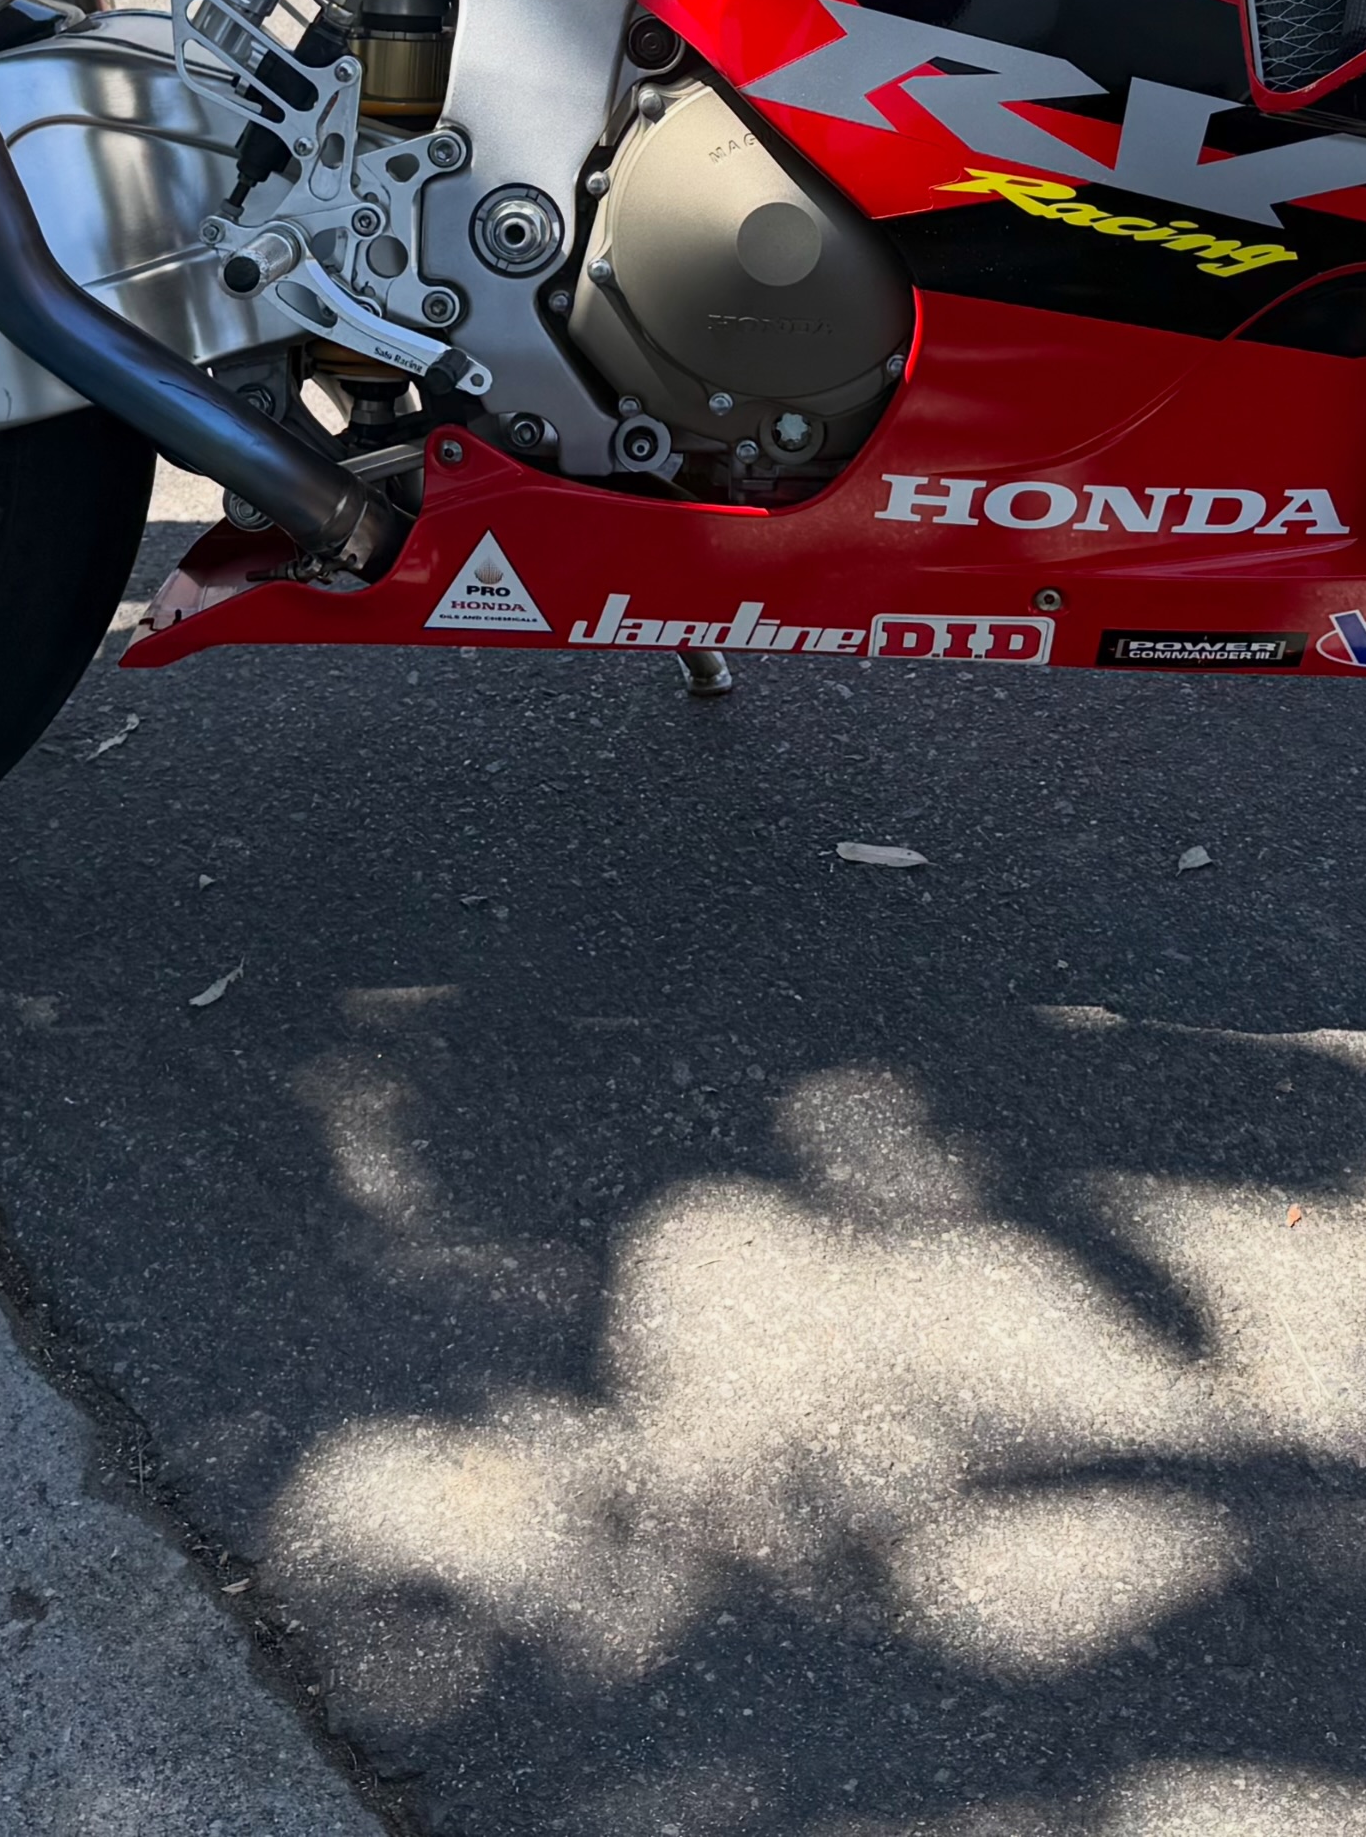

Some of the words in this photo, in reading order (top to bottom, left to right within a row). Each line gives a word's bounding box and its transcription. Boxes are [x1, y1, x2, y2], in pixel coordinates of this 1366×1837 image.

[932, 165, 1299, 279] Racing
[874, 473, 1351, 535] HONDA
[466, 585, 511, 597] PRO
[450, 600, 527, 613] HONDA
[568, 592, 866, 654] Jardine
[1128, 641, 1276, 652] POWER
[1128, 650, 1252, 660] COMMANDER
